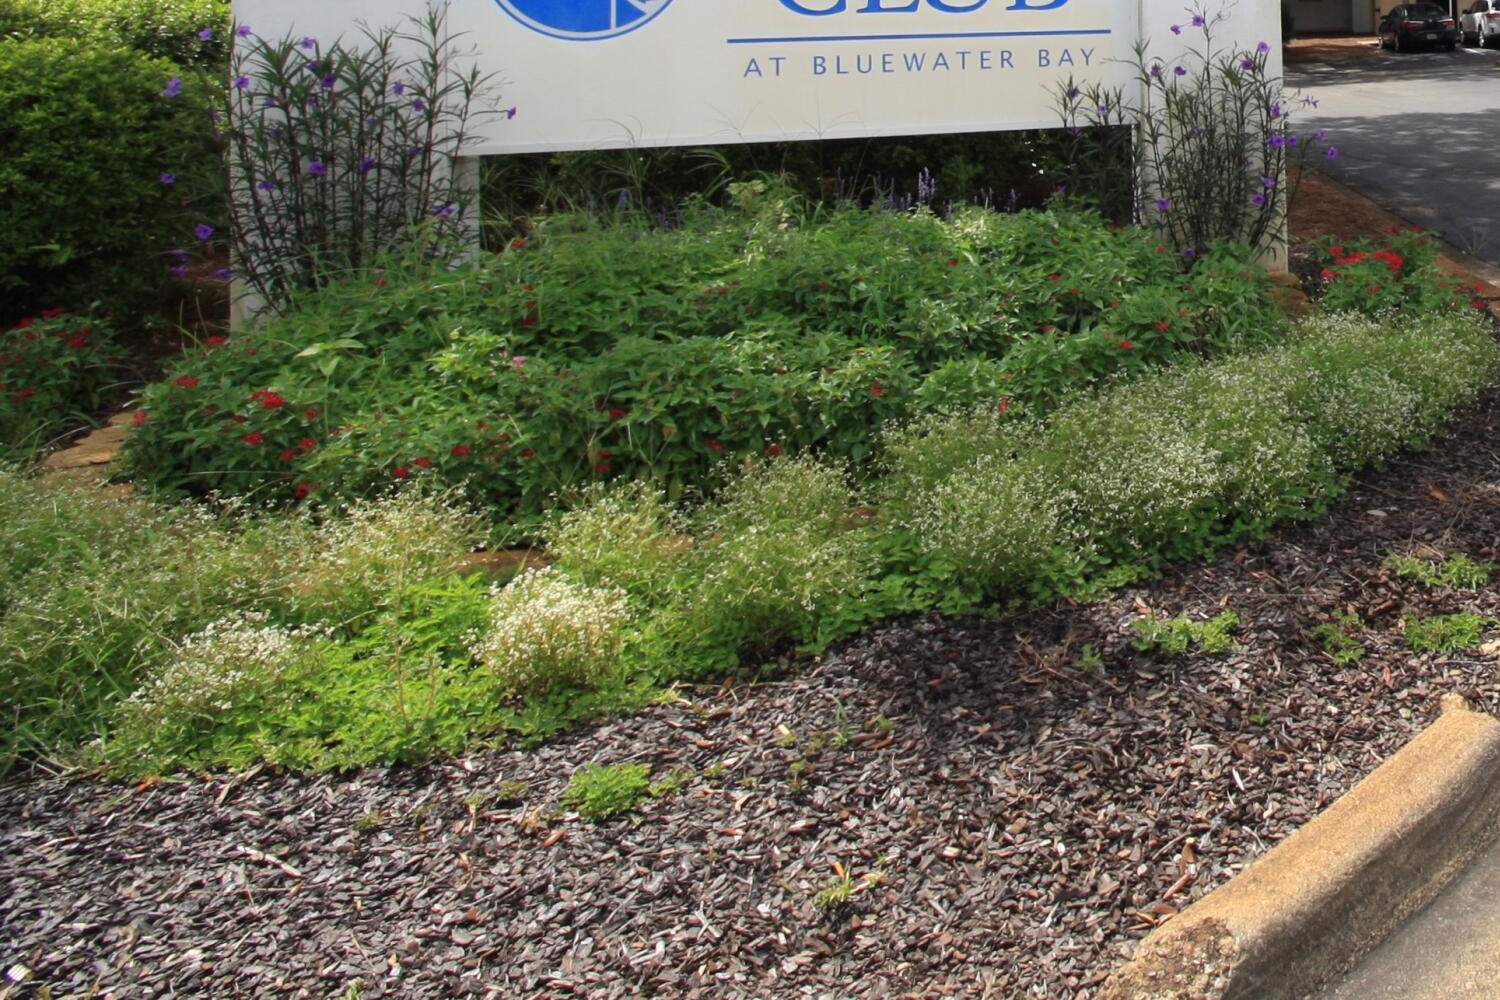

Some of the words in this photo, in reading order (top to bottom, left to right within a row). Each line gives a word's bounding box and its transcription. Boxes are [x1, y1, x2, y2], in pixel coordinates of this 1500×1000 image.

[743, 56, 787, 78] AT
[813, 50, 1014, 75] BLUEWATER
[1038, 47, 1095, 68] BAY
